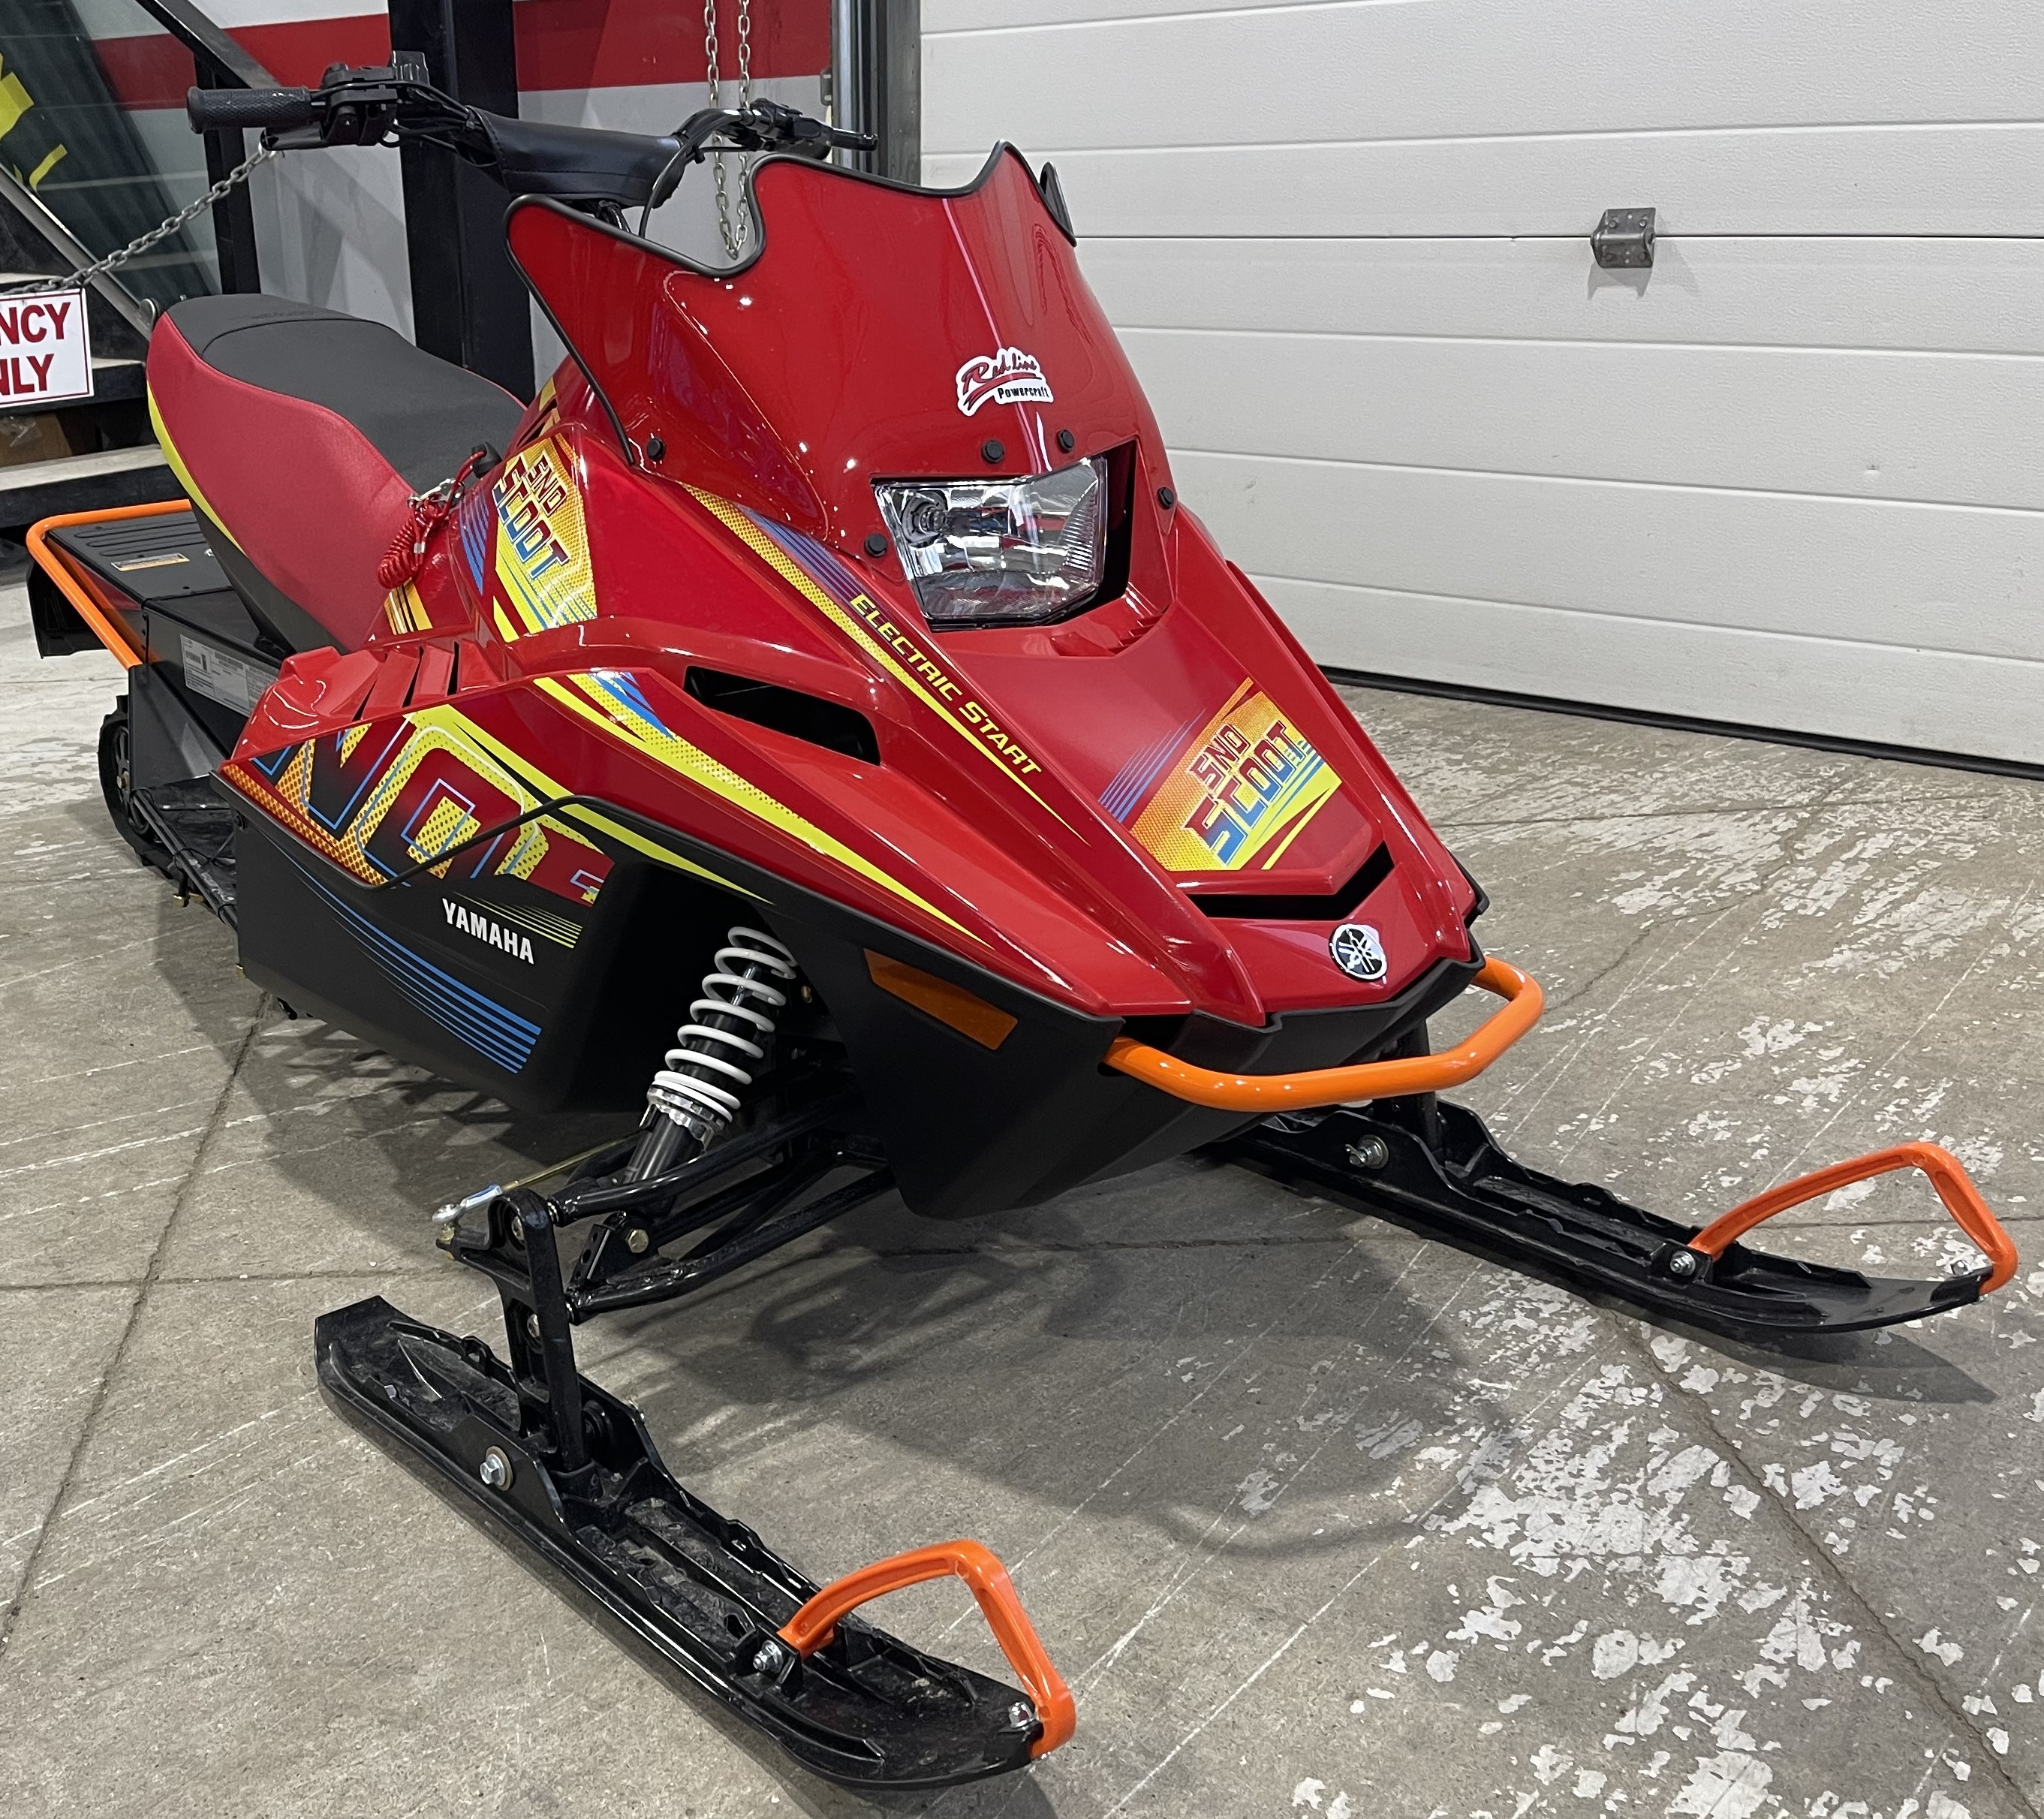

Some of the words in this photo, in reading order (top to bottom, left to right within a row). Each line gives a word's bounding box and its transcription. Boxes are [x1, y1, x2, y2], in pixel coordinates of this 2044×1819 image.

[0, 302, 71, 345] NCY
[998, 387, 1049, 399] Powercraft
[492, 456, 570, 580] SCOOT
[850, 593, 962, 701] ELECTRIC
[959, 701, 1042, 774] START
[1181, 719, 1305, 867] SCOOT
[442, 898, 534, 965] YAMAHA
